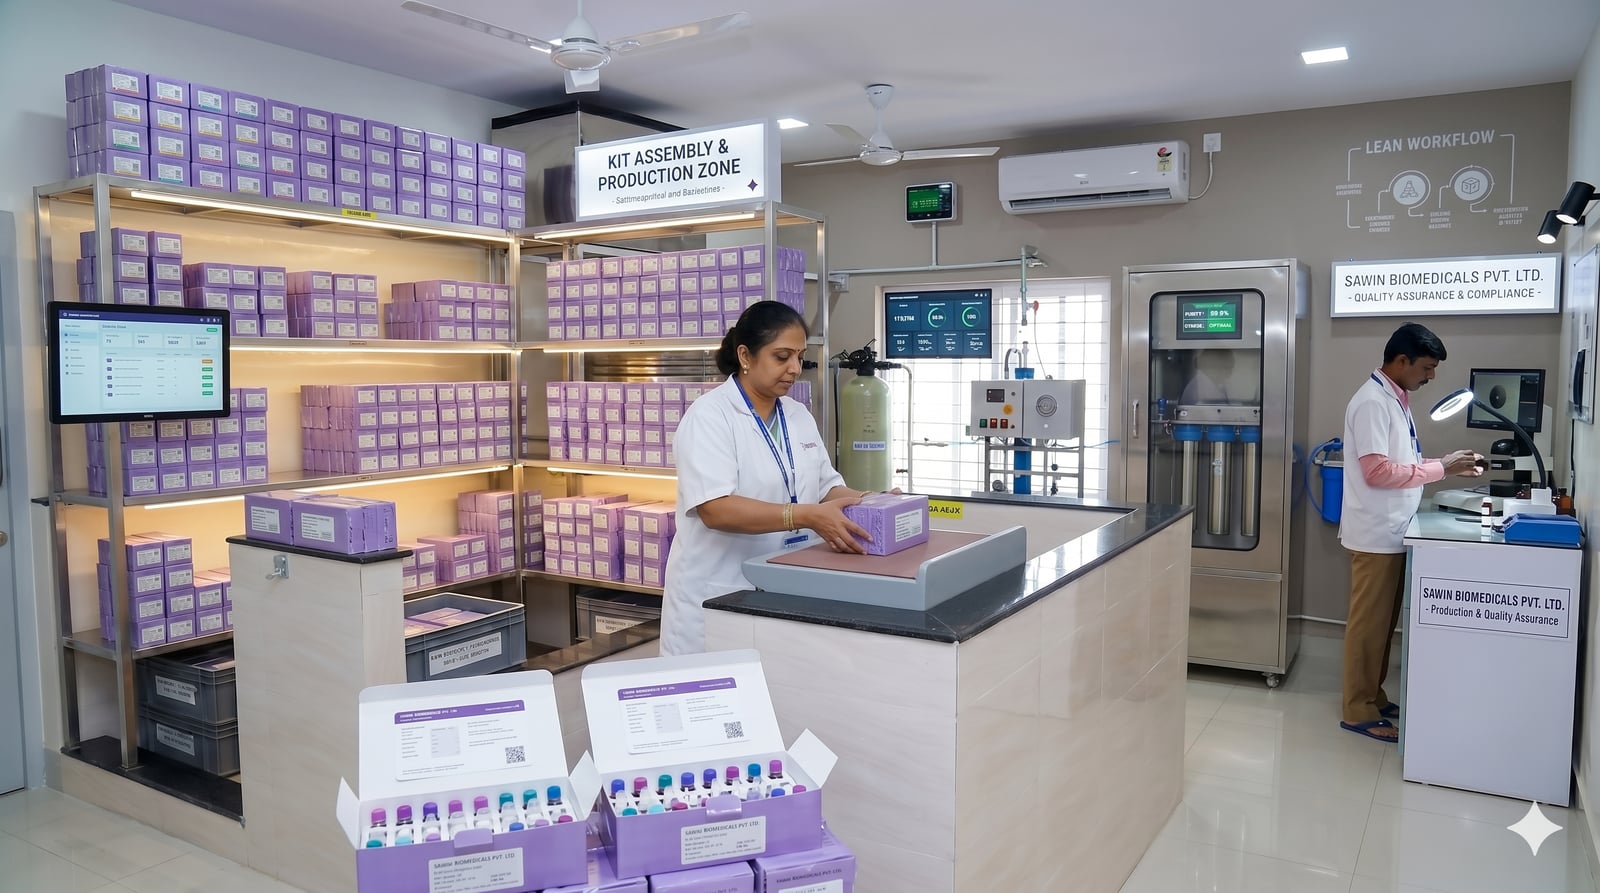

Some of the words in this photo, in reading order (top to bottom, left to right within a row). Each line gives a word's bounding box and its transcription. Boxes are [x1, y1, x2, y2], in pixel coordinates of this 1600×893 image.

[1366, 138, 1403, 154] LEAN
[1407, 129, 1495, 151] WORKFLOW
[608, 152, 631, 170] KIT
[634, 140, 714, 166] ASSEMBLY
[718, 138, 729, 154] &
[598, 164, 693, 191] PRODUCTION
[698, 158, 741, 179] ZONE
[668, 189, 681, 198] and
[1344, 274, 1386, 287] SAWIN
[1389, 270, 1479, 286] BIOMEDICALS
[1483, 269, 1511, 283] PVT.
[1516, 268, 1544, 282] LTD.
[1354, 292, 1394, 303] QUALITY
[1396, 290, 1456, 301] ASSURANCE
[1457, 290, 1464, 300] &
[1467, 288, 1535, 300] COMPLIANCE
[1423, 587, 1453, 601] SAWIN
[1455, 590, 1519, 607] BIOMEDICALS
[1521, 596, 1541, 609] PVT.
[1544, 598, 1565, 611] LTD.
[1430, 604, 1473, 618] Production
[1476, 608, 1482, 619] &
[1484, 609, 1513, 624] Quality
[1515, 612, 1559, 626] Assurance
